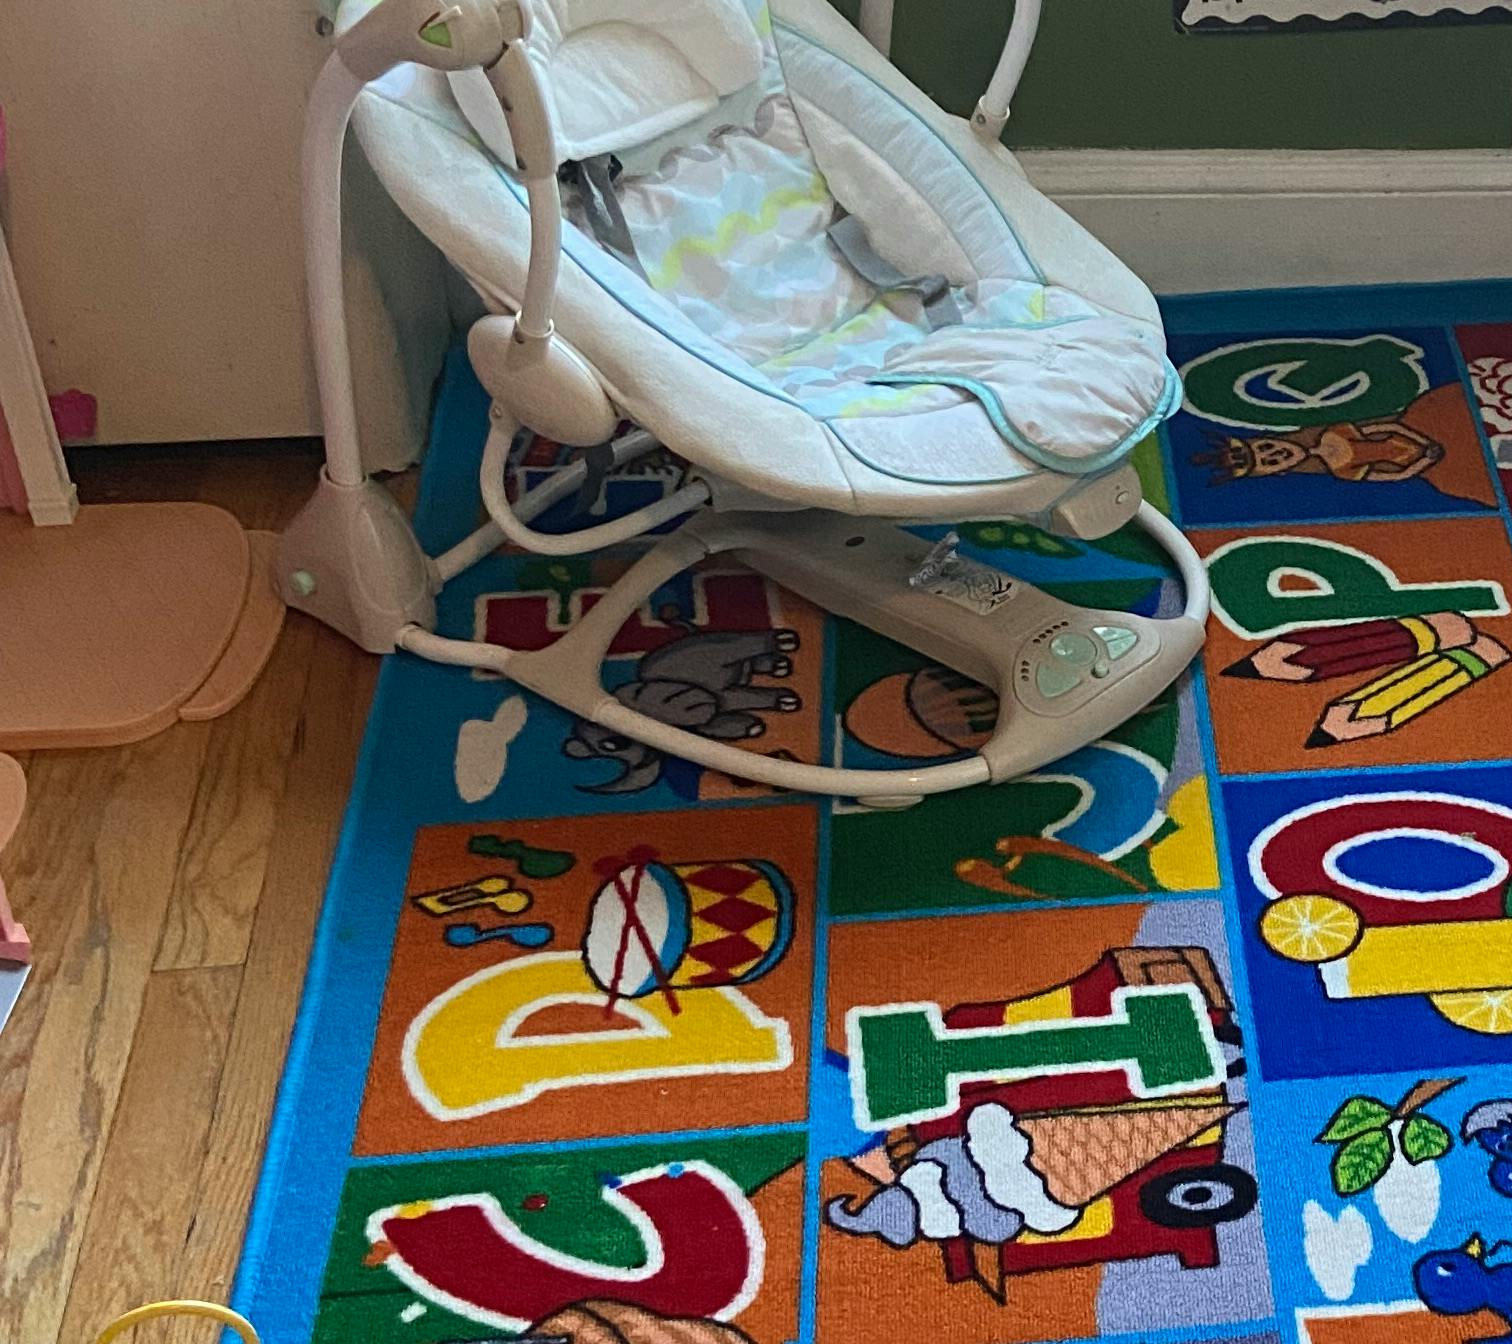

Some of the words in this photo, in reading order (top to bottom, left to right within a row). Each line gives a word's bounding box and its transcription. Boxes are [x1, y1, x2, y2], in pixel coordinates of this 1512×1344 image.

[1200, 535, 1512, 639] P
[401, 950, 793, 1120] D
[846, 983, 1228, 1131] I
[367, 1160, 766, 1331] C
